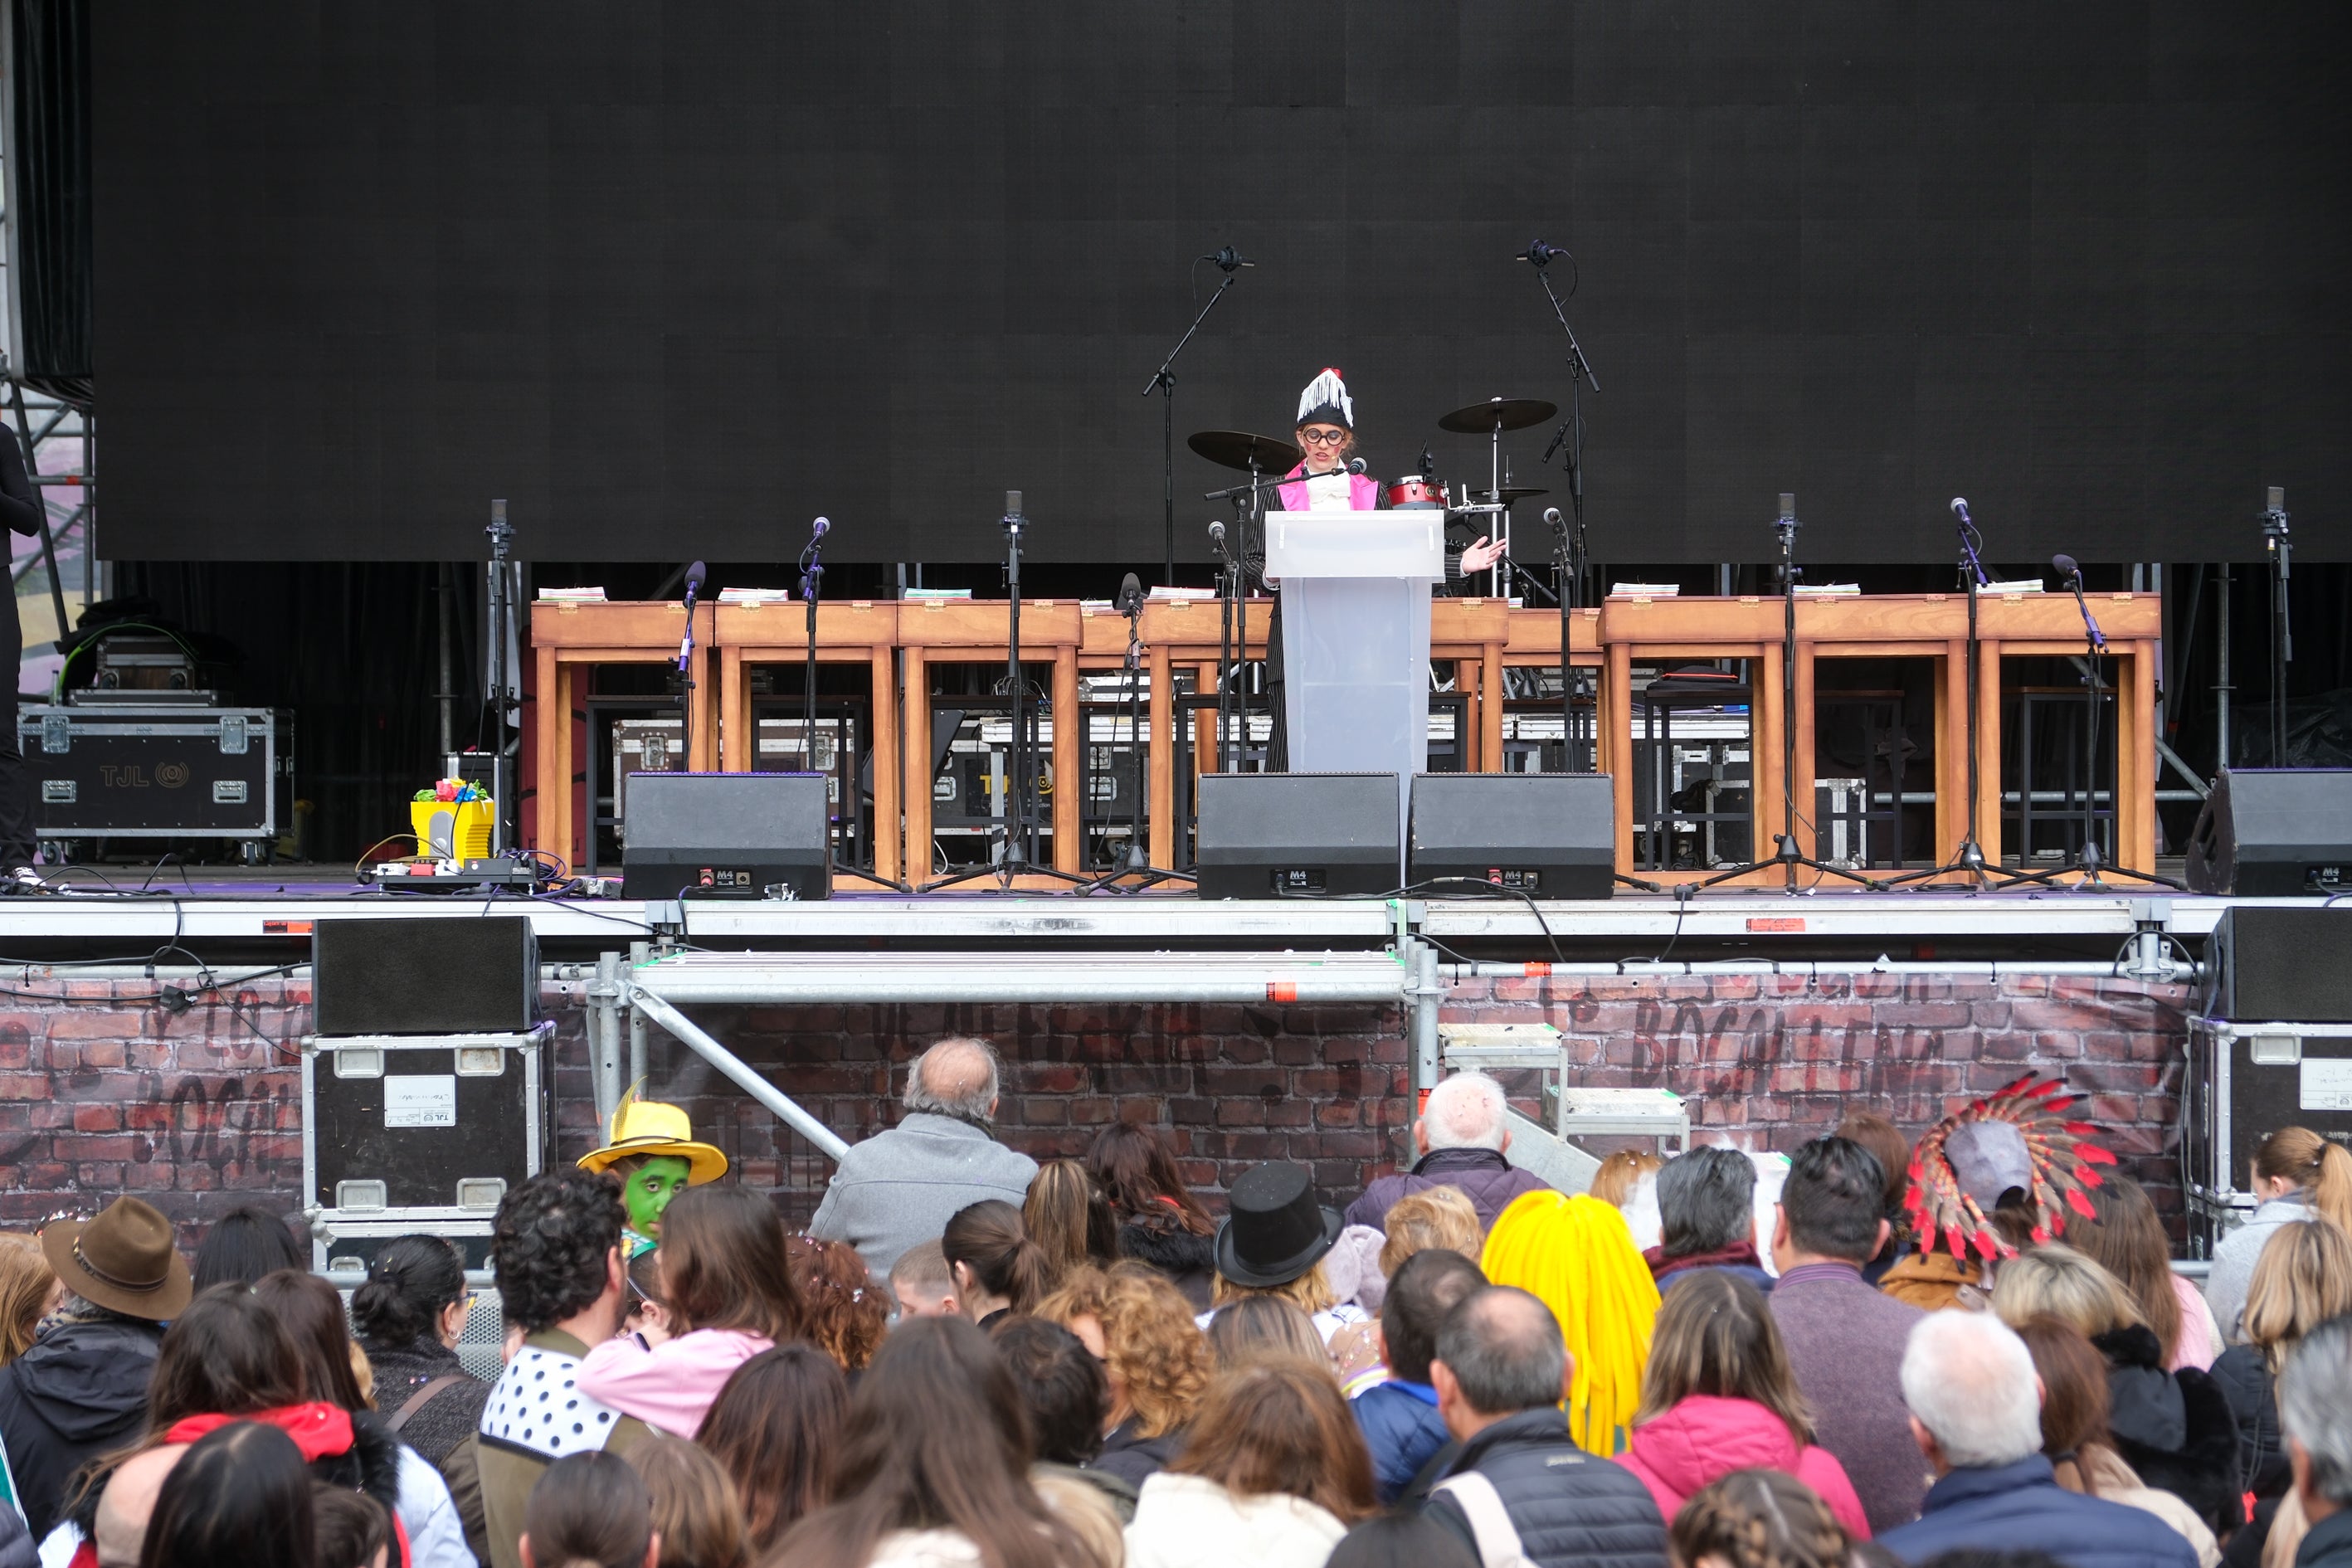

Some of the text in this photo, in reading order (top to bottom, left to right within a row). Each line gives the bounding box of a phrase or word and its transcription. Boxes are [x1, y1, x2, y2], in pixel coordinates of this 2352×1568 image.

[100, 765, 150, 787] TJL
[717, 870, 733, 879] M4
[1290, 870, 1307, 879] M4
[1505, 870, 1522, 879] M4
[2322, 867, 2340, 876] M4
